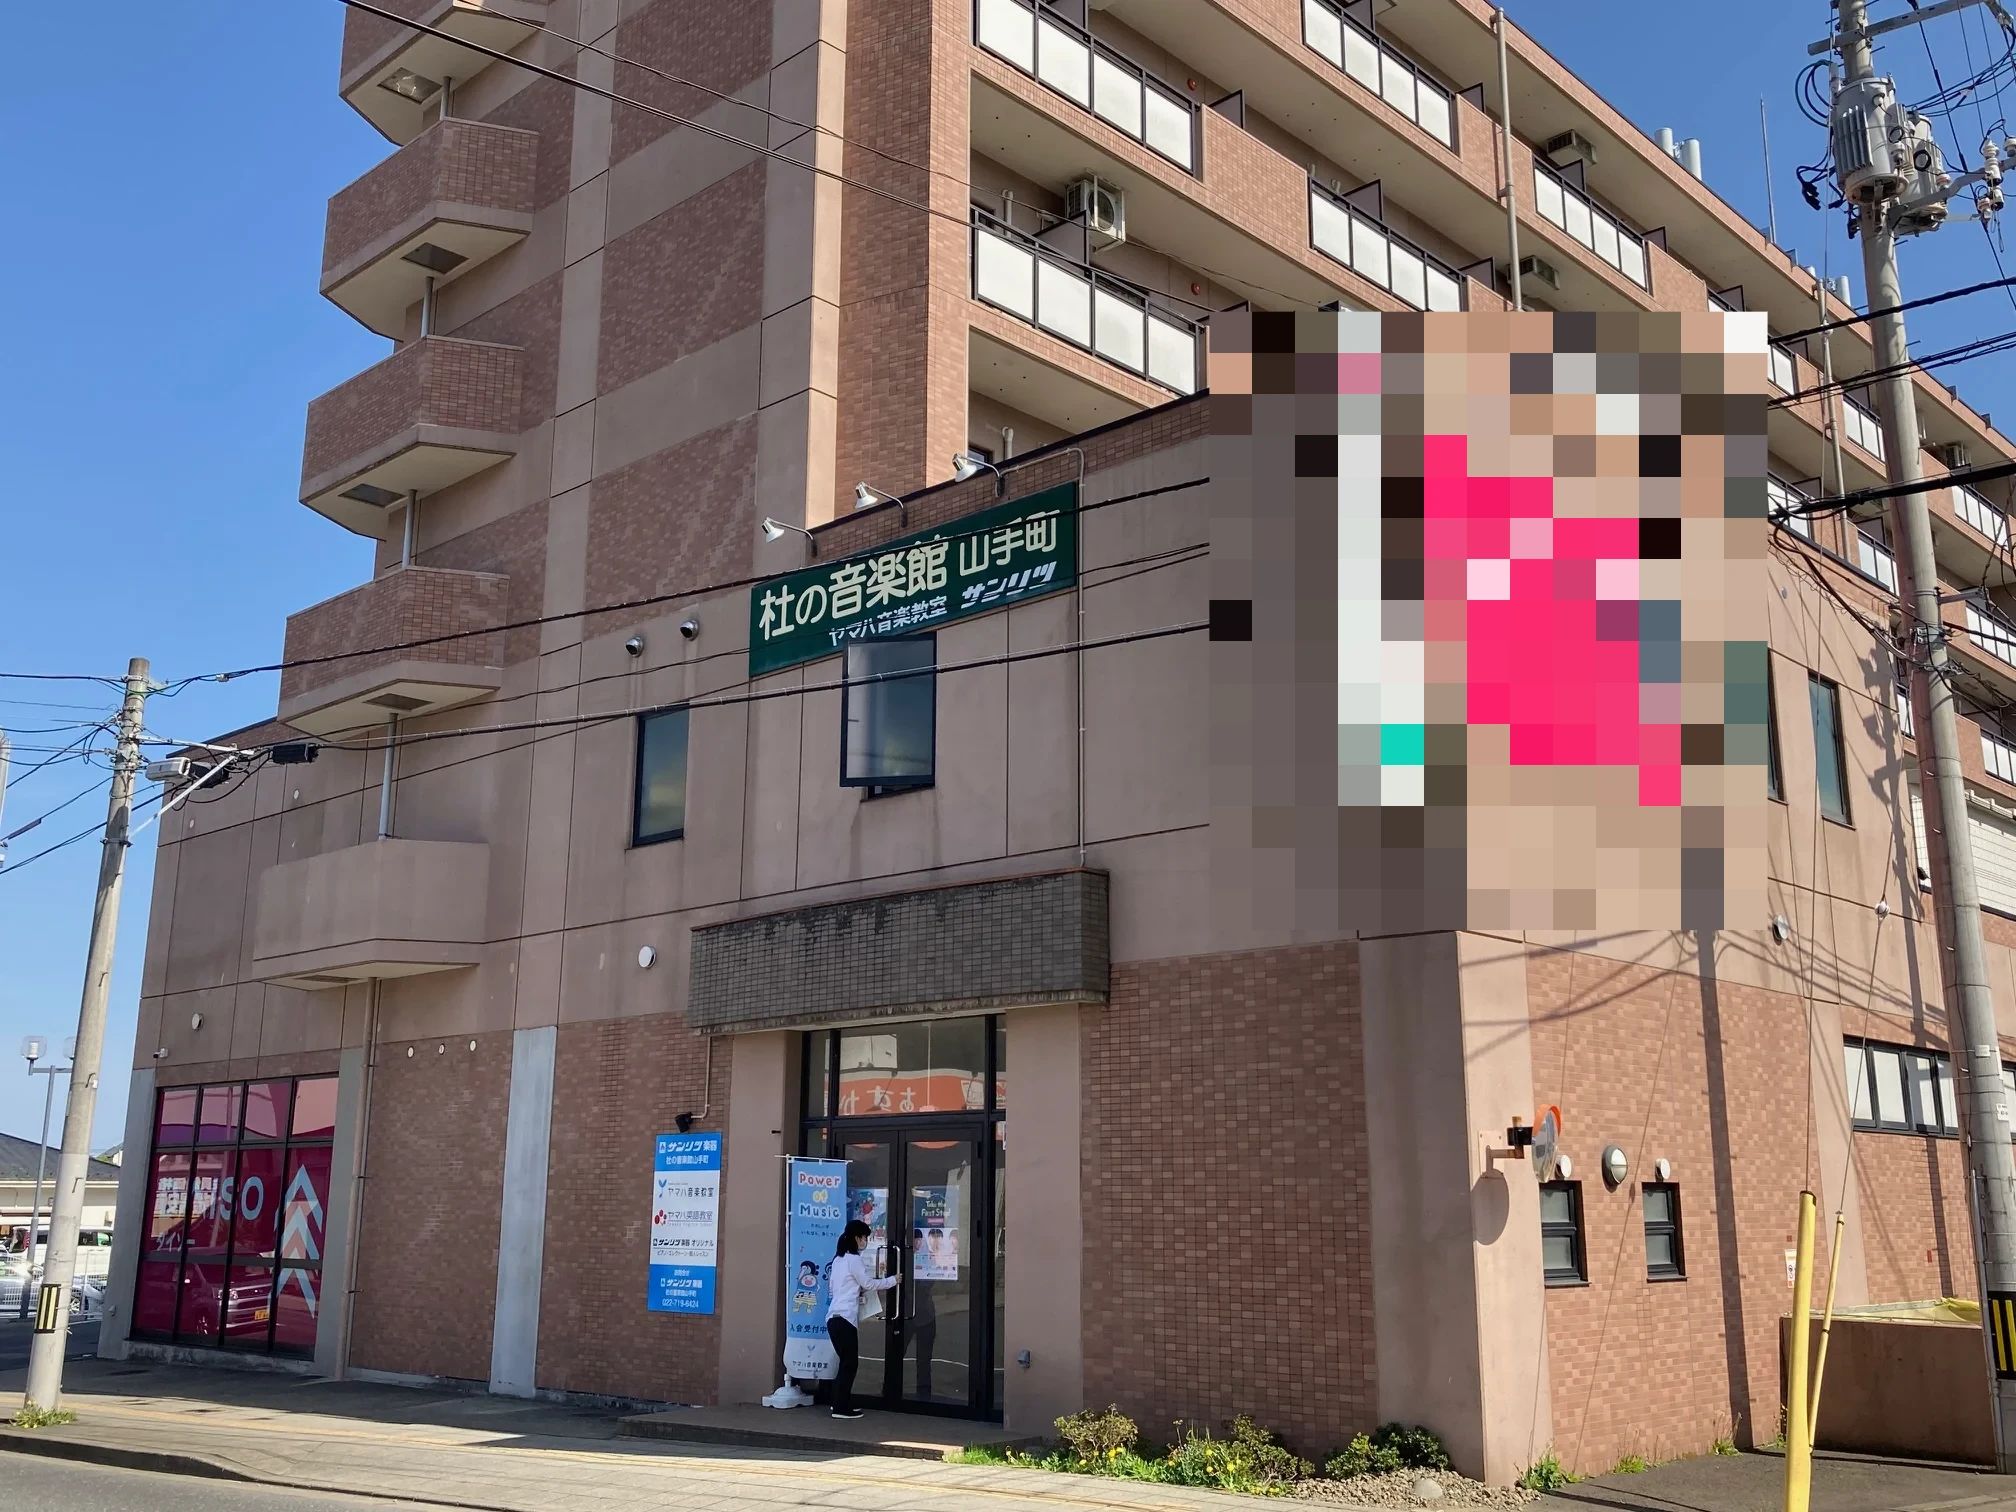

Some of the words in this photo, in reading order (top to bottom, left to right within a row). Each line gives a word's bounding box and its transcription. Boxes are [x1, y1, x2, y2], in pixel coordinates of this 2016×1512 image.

[758, 533, 950, 641] 杜の音楽館
[959, 509, 1060, 578] 山手町
[828, 595, 948, 647] ヤマハ音楽教室
[960, 560, 1058, 609] サンリツ
[798, 1171, 842, 1187] Power
[668, 1187, 715, 1198] ヤマハ音楽教室
[813, 1189, 829, 1203] of
[799, 1203, 841, 1218] Music
